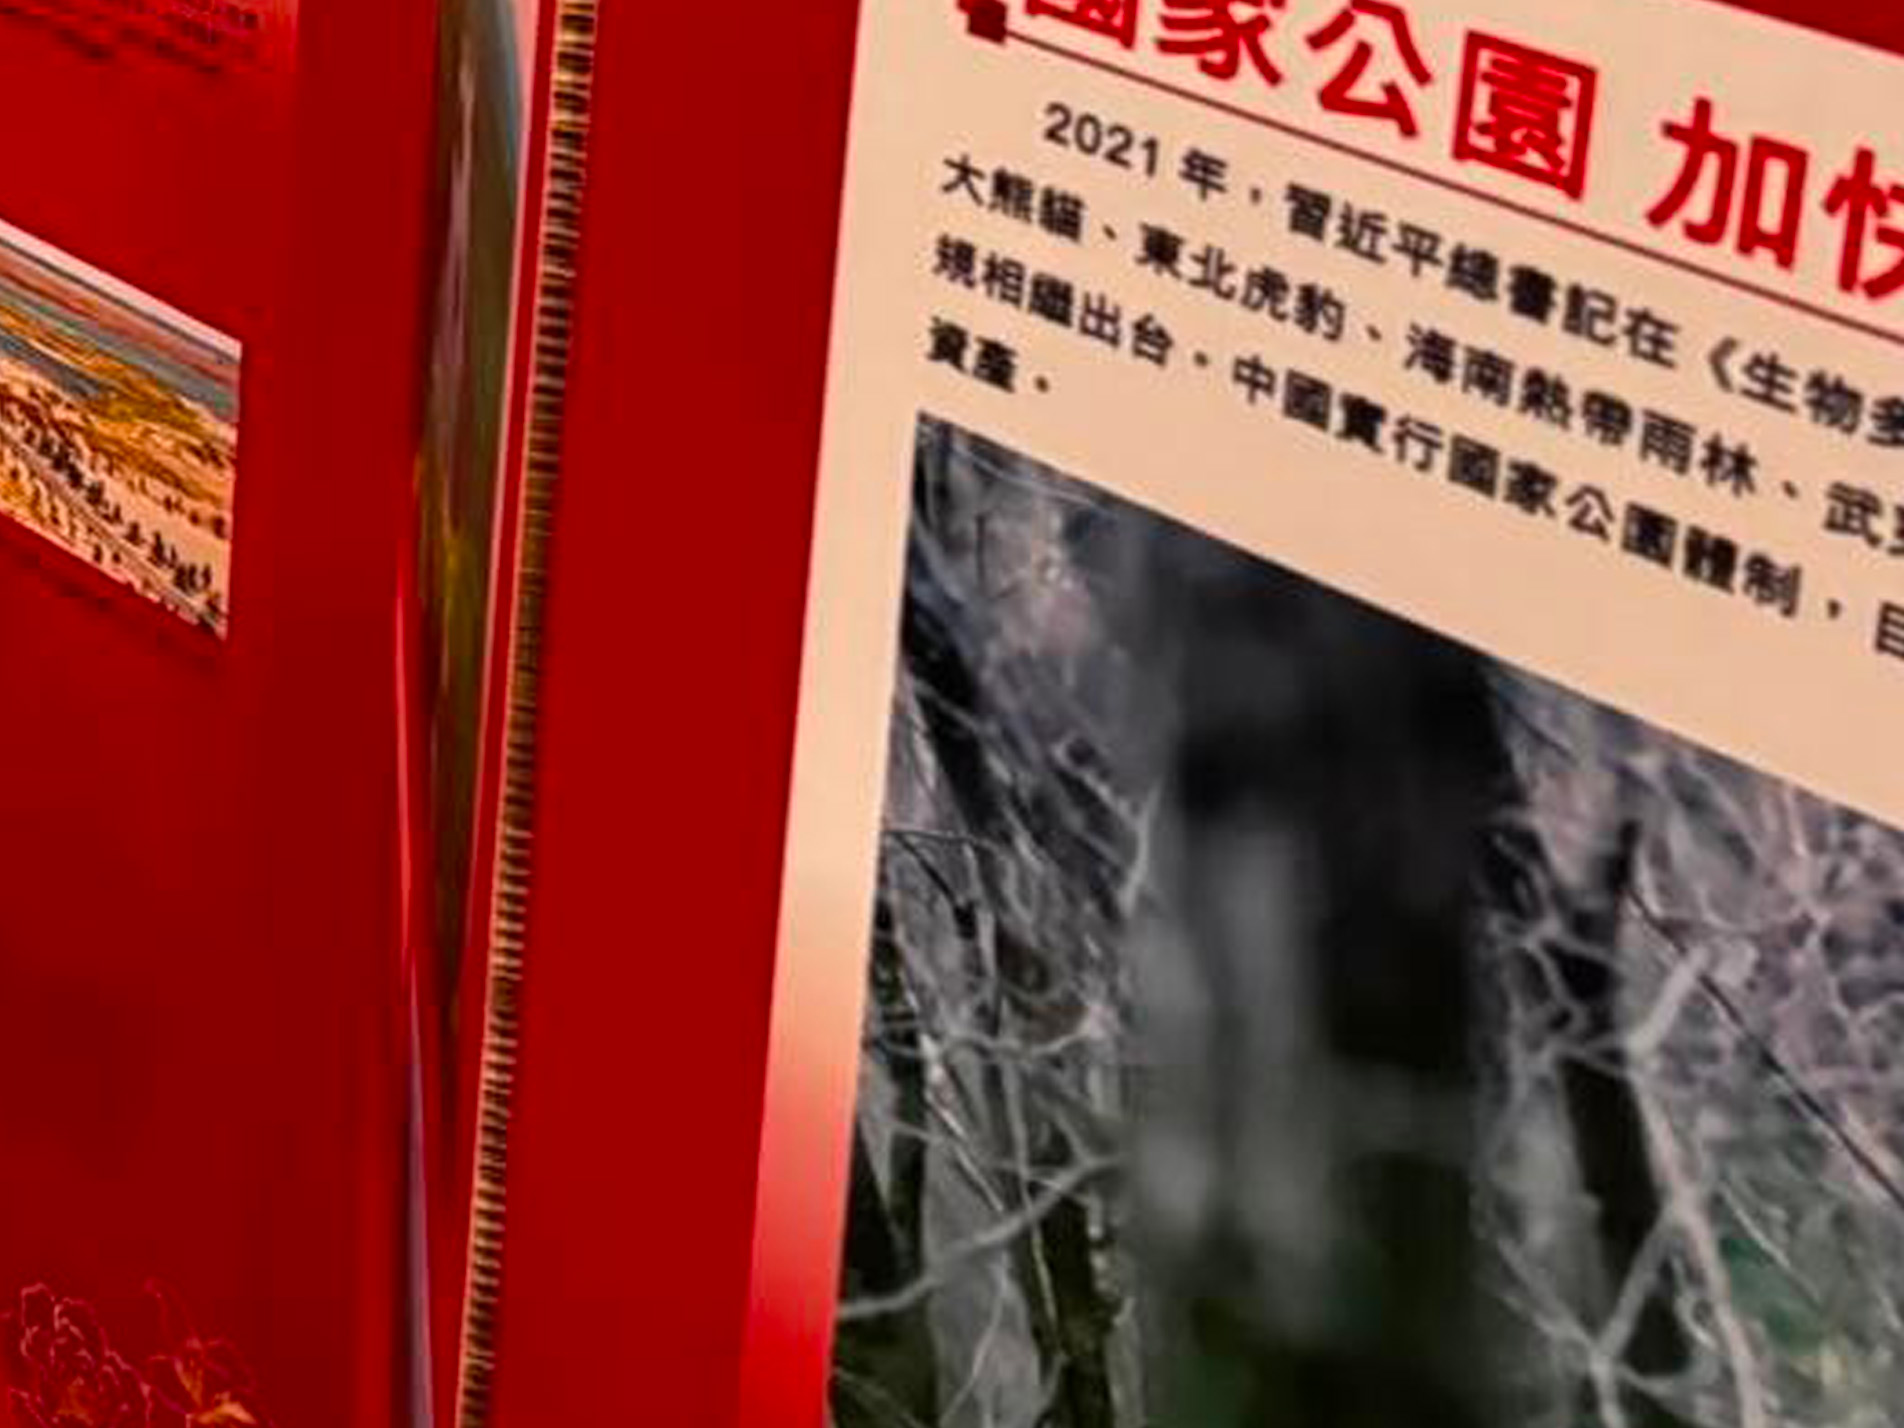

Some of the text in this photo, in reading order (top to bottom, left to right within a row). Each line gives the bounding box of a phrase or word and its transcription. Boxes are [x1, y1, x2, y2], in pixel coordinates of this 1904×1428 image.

[940, 154, 1904, 556] 大熊貓、東北虎豹、海南熱帶雨林、武
